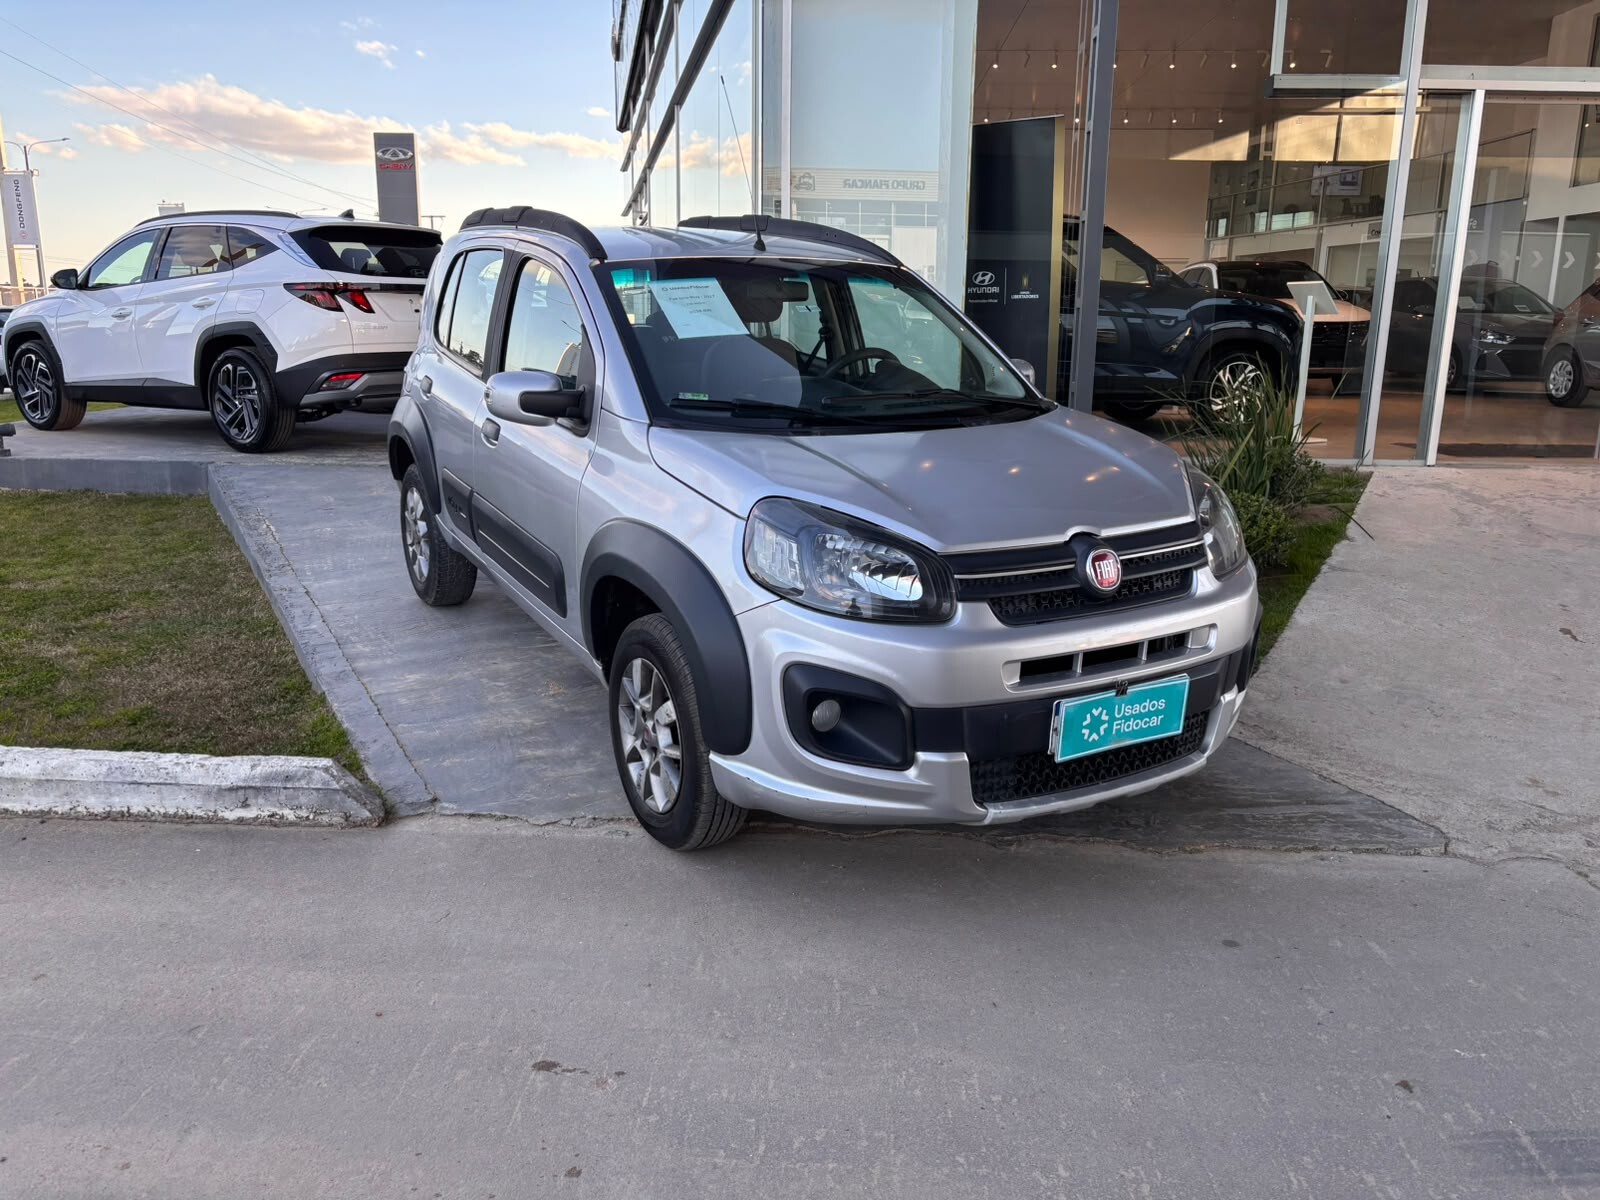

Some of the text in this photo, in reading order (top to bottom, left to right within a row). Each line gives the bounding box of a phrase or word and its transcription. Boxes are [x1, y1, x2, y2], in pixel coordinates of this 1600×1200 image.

[967, 286, 1000, 294] HYUNDAI
[1095, 559, 1115, 580] FIAT
[1114, 698, 1166, 719] Usados
[1112, 714, 1164, 735] Fidocar
